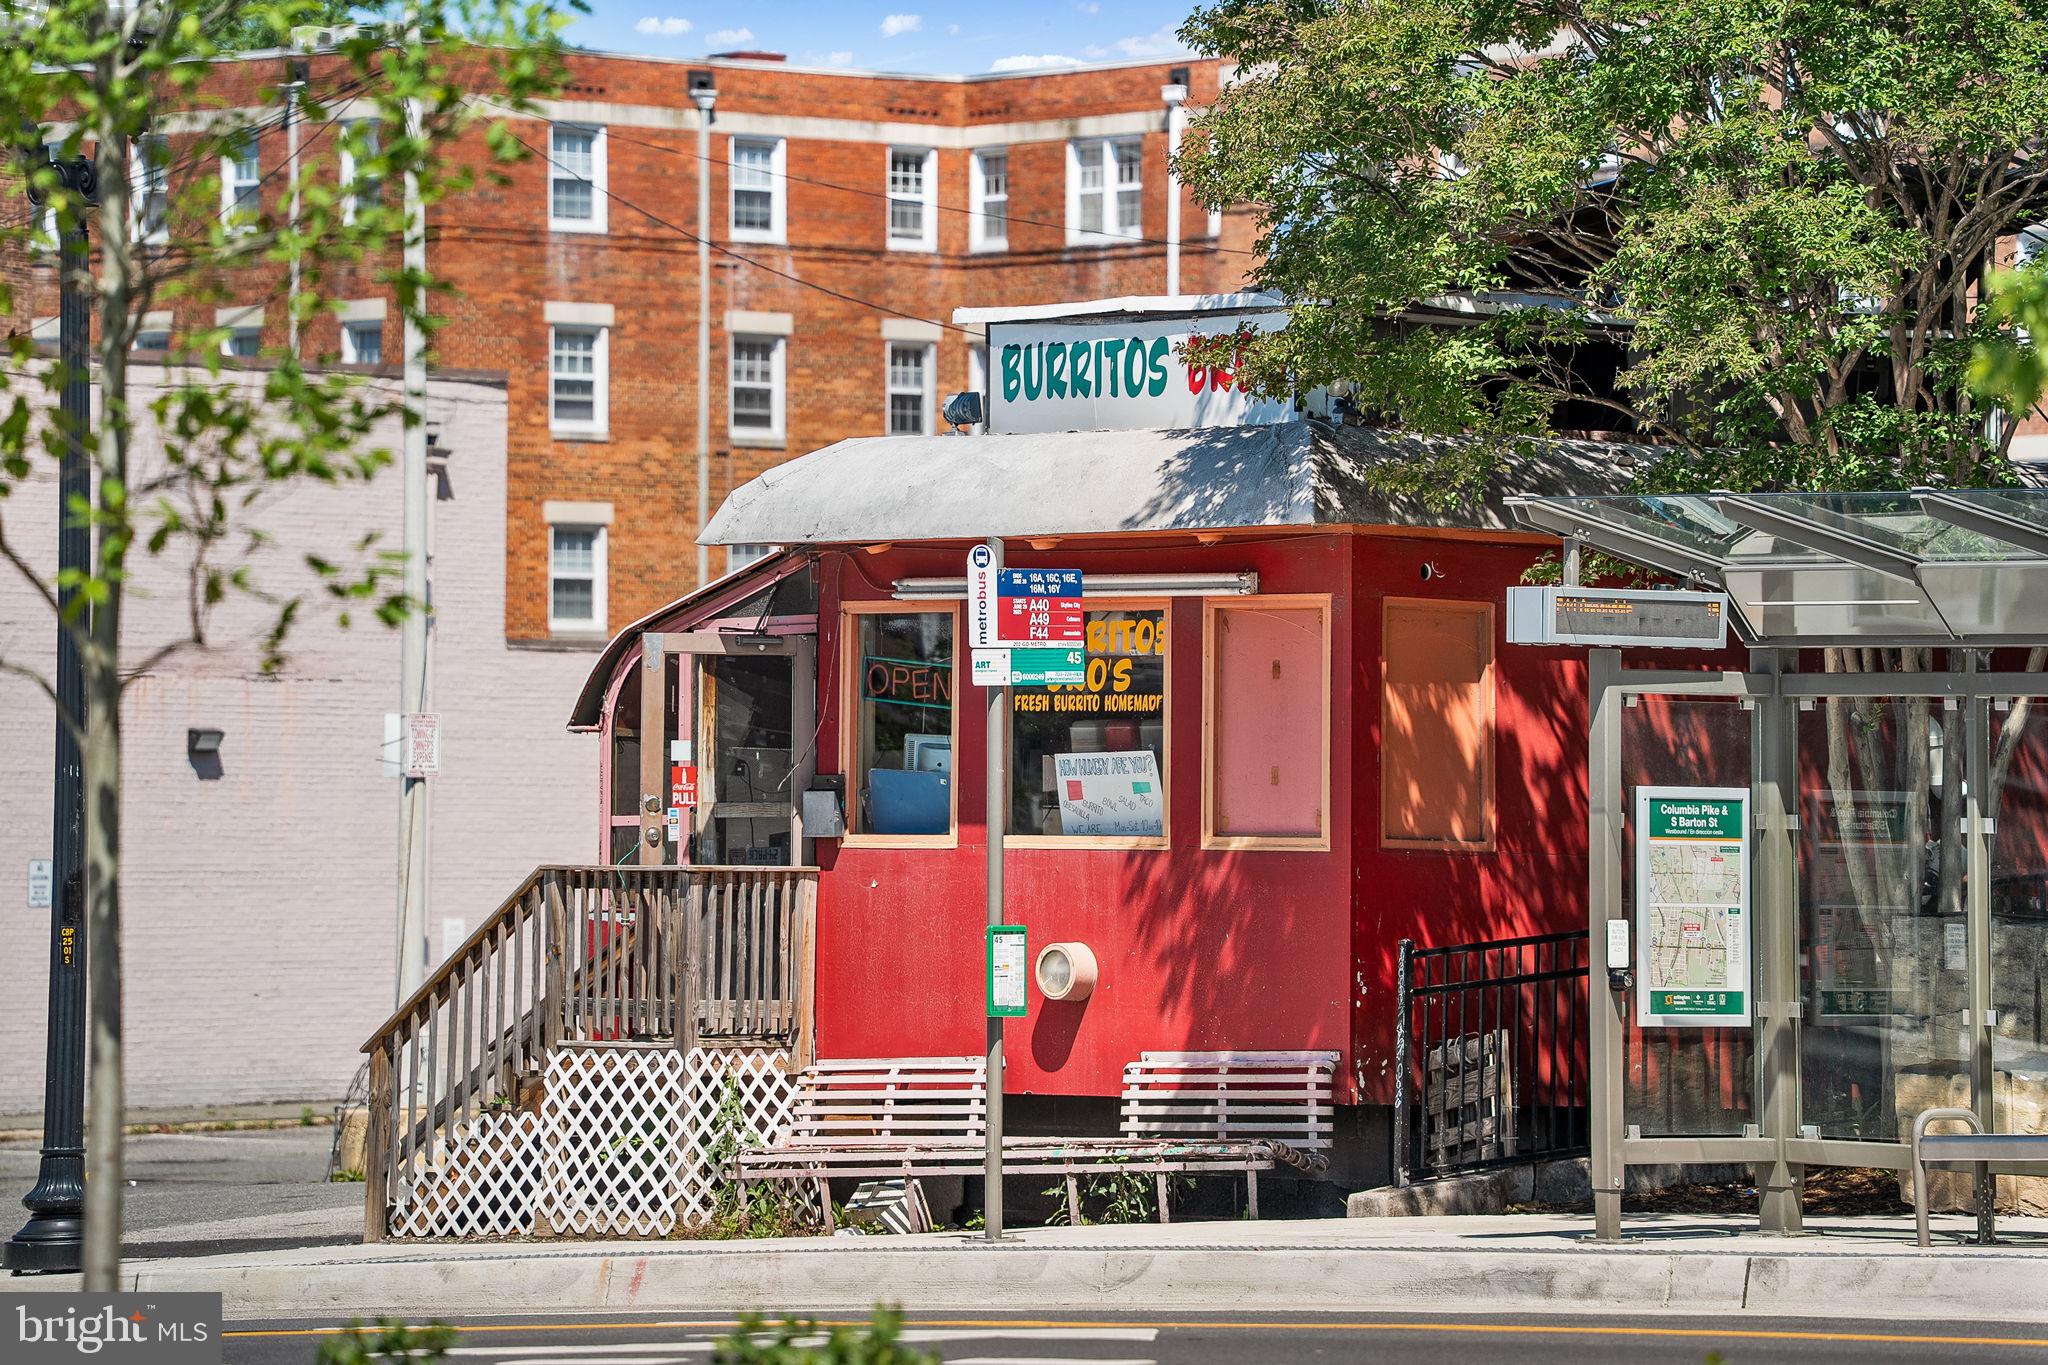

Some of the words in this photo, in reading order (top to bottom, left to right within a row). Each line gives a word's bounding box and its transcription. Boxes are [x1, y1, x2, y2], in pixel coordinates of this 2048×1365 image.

[1001, 336, 1170, 403] BURRITOS
[1029, 572, 1045, 584] 16A,
[1046, 573, 1062, 584] 16C,
[1062, 573, 1078, 584] 16E,
[1029, 584, 1047, 594] 16M,
[1048, 584, 1061, 594] 16Y
[977, 571, 987, 645] metrobus
[1029, 599, 1050, 612] A40
[1029, 612, 1050, 626] A49
[1029, 626, 1049, 640] F44
[1066, 652, 1082, 664] 45
[975, 660, 992, 669] ART
[868, 664, 952, 701] OPEN
[1014, 694, 1050, 712] FRESH
[1054, 694, 1100, 712] BURRITO
[1059, 757, 1078, 777] HOW
[1111, 756, 1130, 775] ARE
[673, 792, 697, 805] PULL
[1660, 804, 1700, 816] Columbia
[1701, 804, 1720, 816] Pike
[1721, 805, 1728, 816] &
[1071, 824, 1086, 834] WE
[1086, 822, 1102, 834] ARE
[1670, 816, 1678, 827] S
[1679, 816, 1706, 828] Barton
[1708, 817, 1718, 828] St
[62, 938, 72, 946] 25
[994, 936, 1003, 944] 45
[65, 956, 70, 964] S
